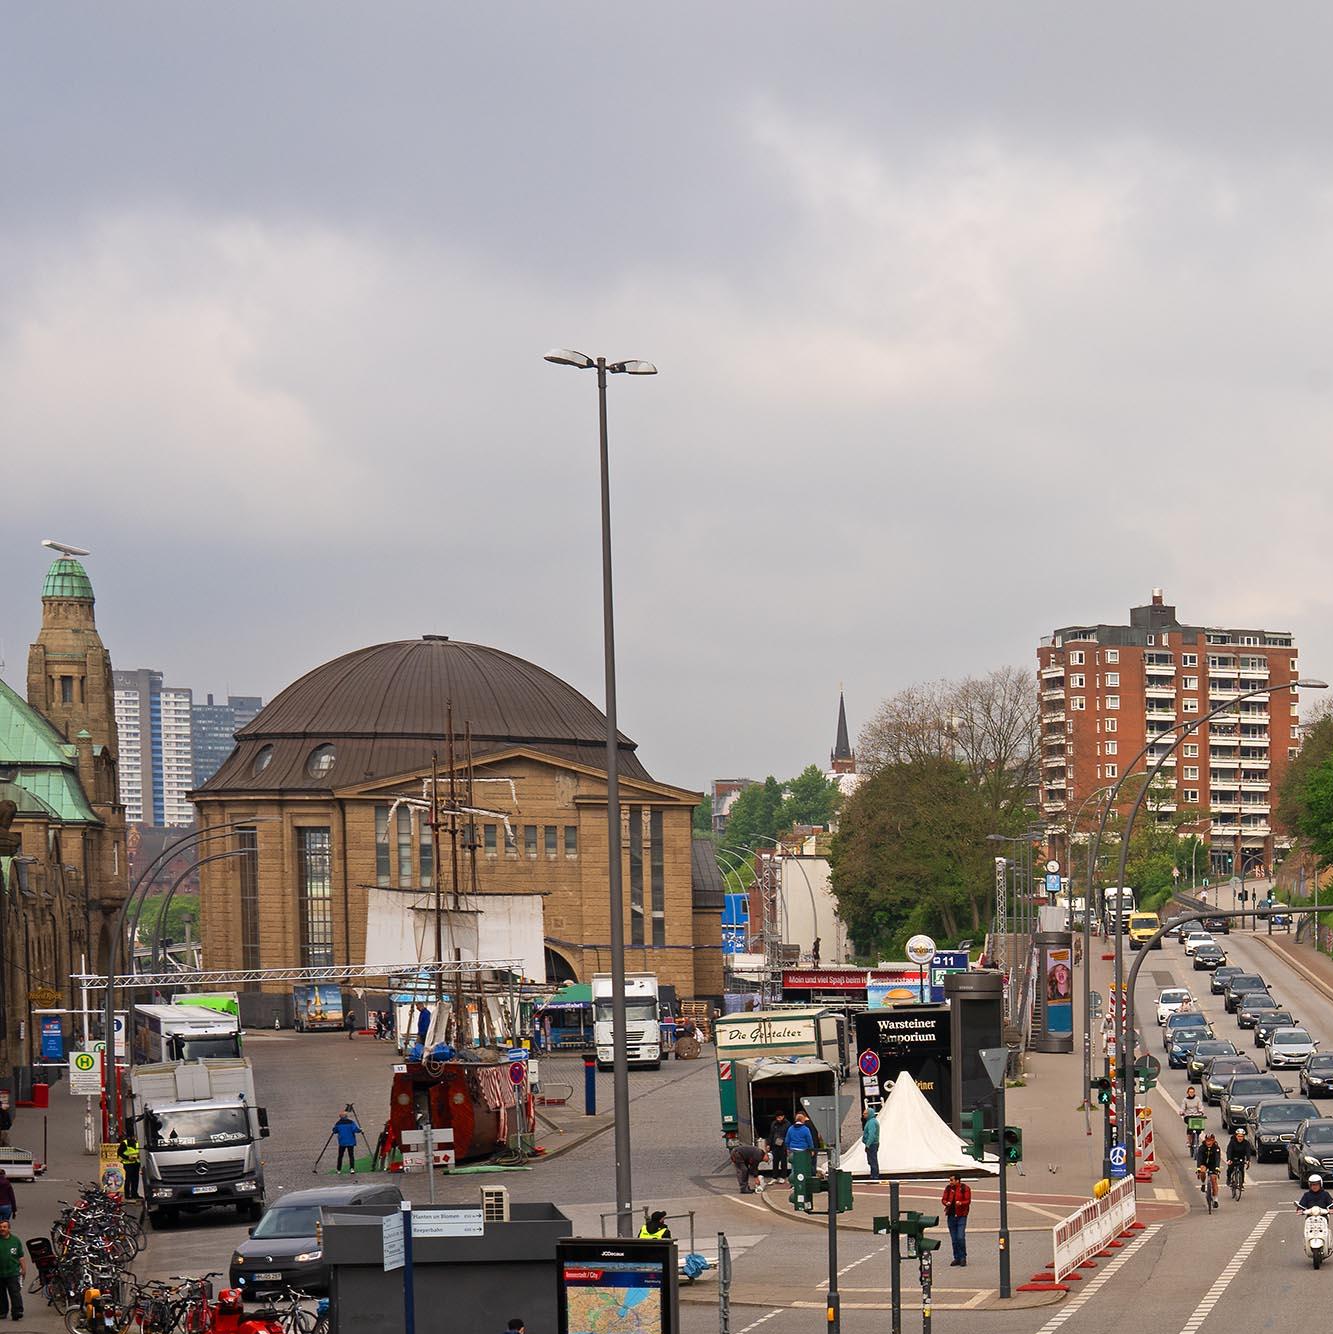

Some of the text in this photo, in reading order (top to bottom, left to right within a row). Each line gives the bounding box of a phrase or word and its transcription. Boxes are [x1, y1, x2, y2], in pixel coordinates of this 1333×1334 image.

[942, 956, 955, 966] 11
[788, 976, 805, 984] Moin
[804, 976, 818, 984] und
[817, 976, 829, 984] viel
[829, 977, 845, 985] Spaß
[845, 976, 861, 984] beim
[877, 1018, 936, 1030] Warsteiner
[728, 1027, 802, 1042] Die Gestalter
[879, 1032, 936, 1043] Emporium
[590, 1271, 599, 1279] City
